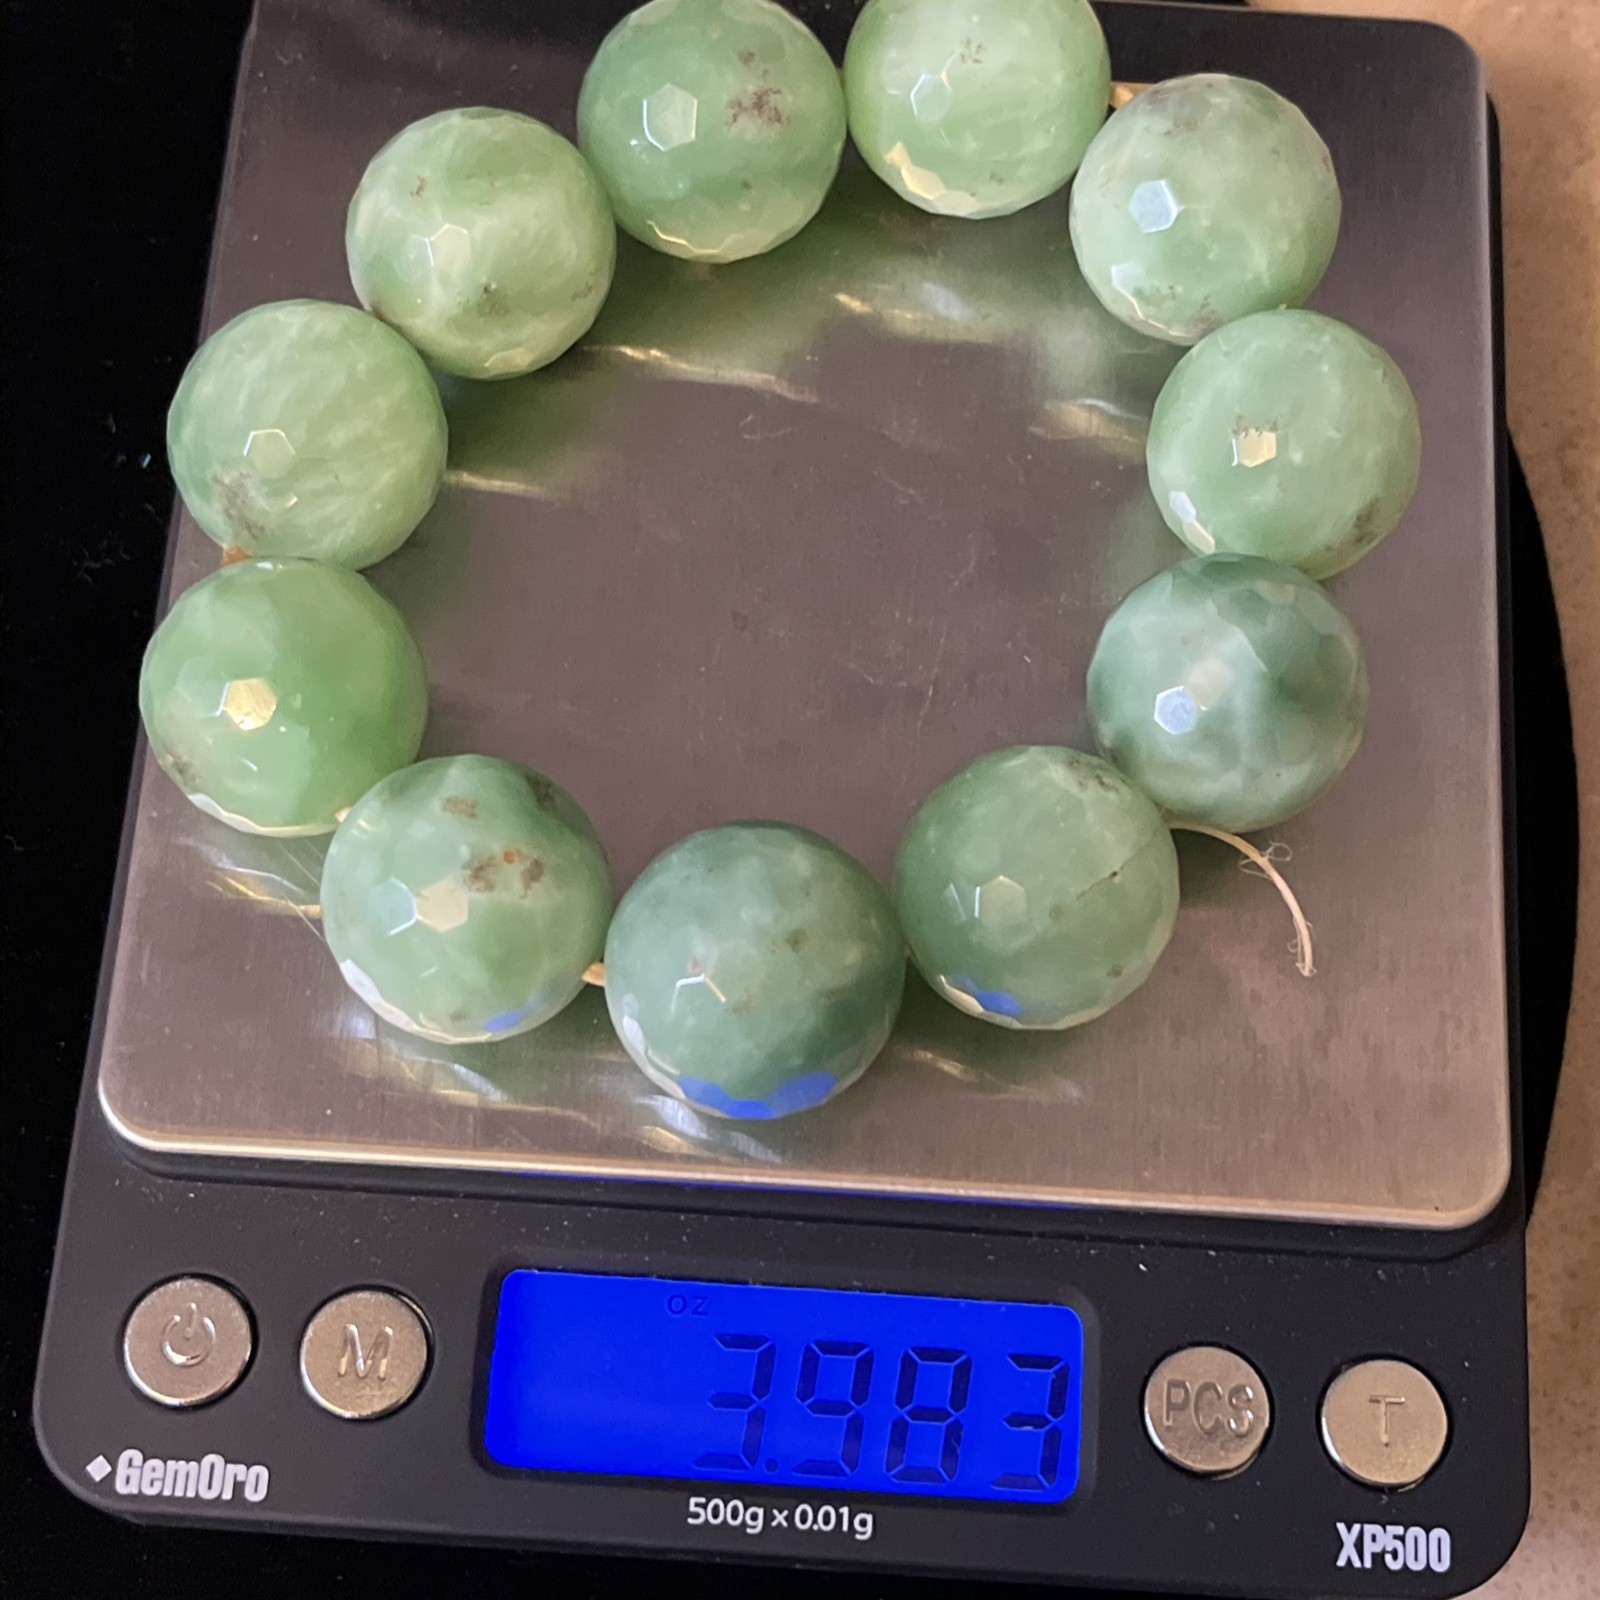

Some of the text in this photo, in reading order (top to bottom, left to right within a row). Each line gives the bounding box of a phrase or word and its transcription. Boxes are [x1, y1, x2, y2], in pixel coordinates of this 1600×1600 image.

[338, 1323, 394, 1379] M
[692, 1333, 1070, 1491] 3.983
[1162, 1378, 1255, 1438] PCS
[1368, 1393, 1406, 1448] T
[114, 1447, 270, 1502] GemOro
[686, 1496, 765, 1535] 500g
[794, 1503, 874, 1540] 0.01g
[1335, 1521, 1452, 1573] XP500
